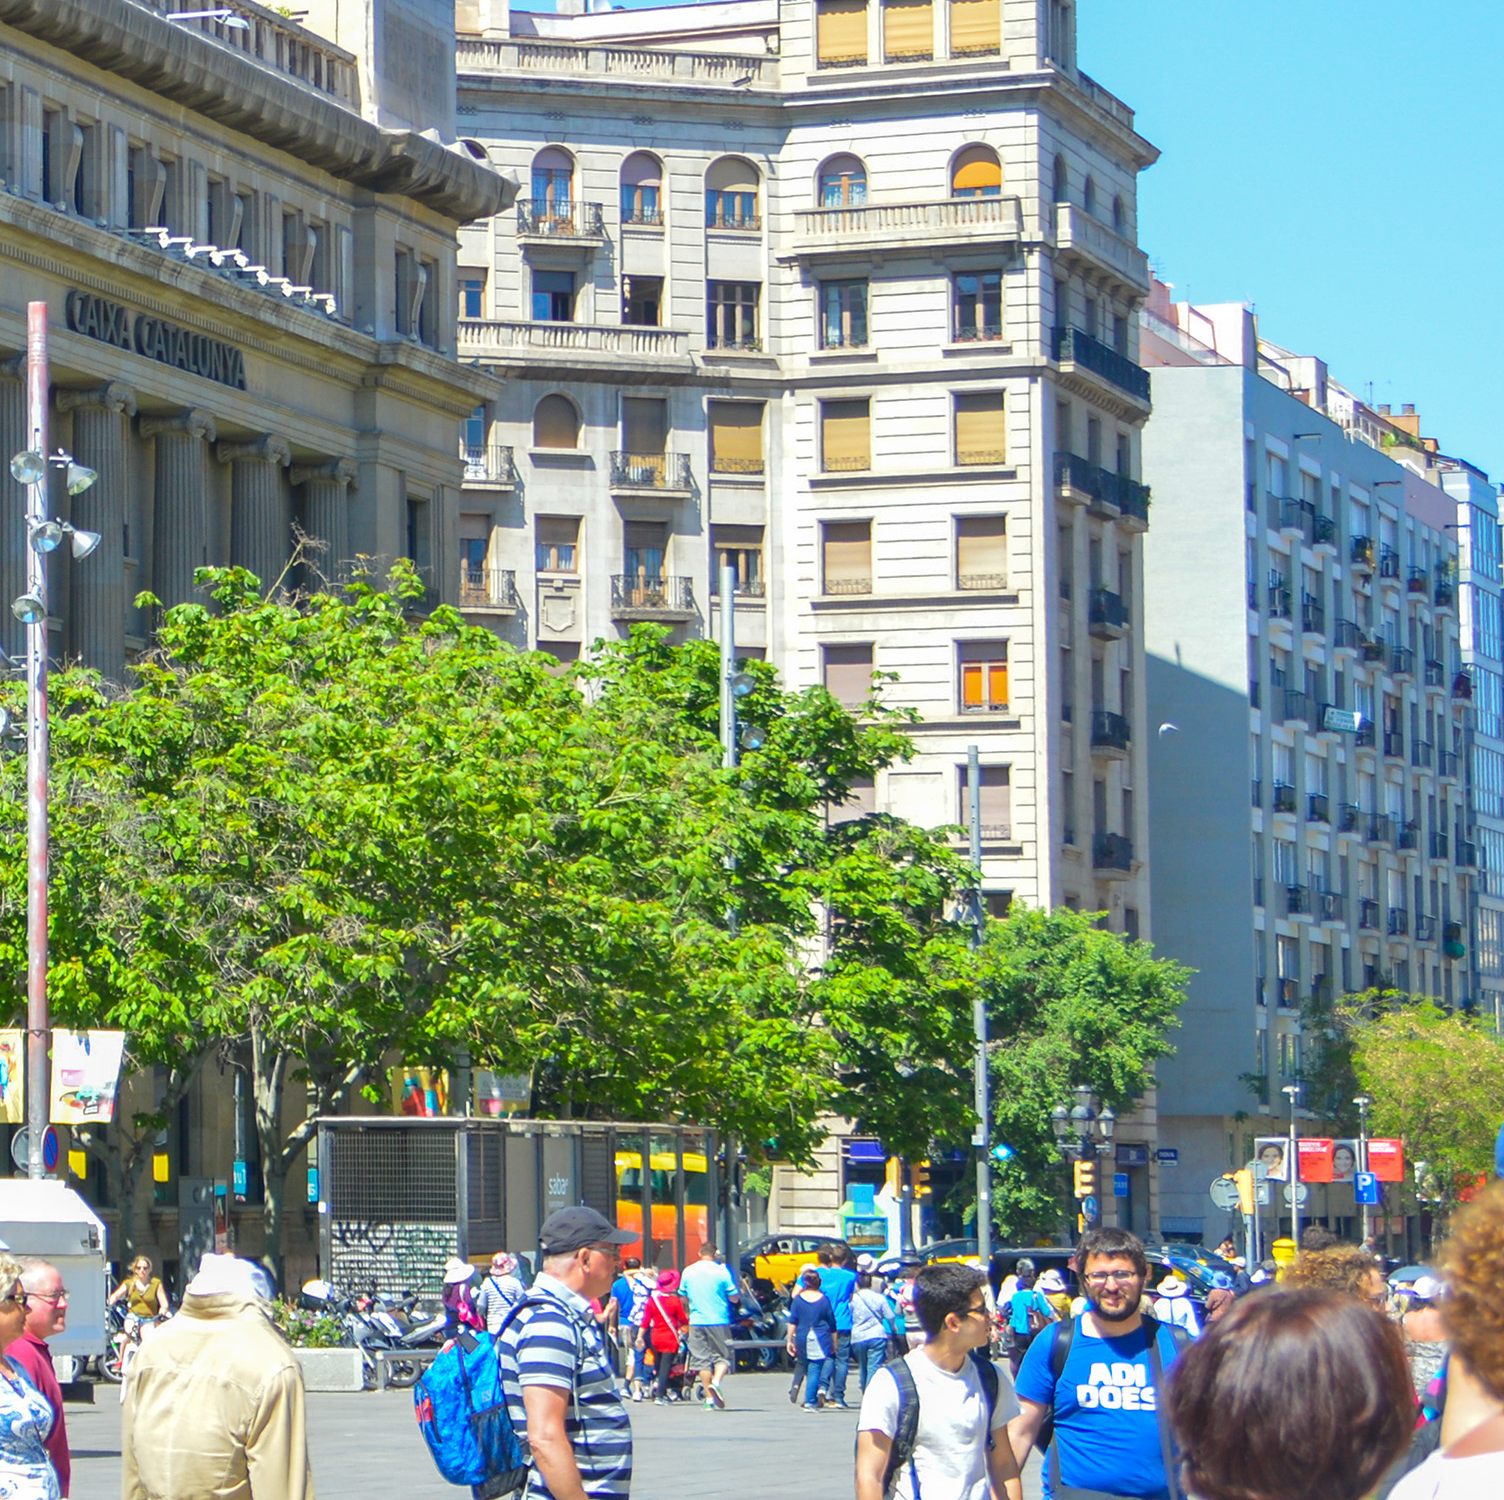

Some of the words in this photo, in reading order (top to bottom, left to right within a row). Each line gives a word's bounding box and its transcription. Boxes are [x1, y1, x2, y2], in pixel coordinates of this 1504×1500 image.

[65, 290, 133, 350] CAIXA
[133, 312, 247, 390] CATALUNYA
[1357, 1174, 1372, 1191] P
[1088, 1362, 1147, 1388] ADI
[1076, 1384, 1157, 1411] DOES
